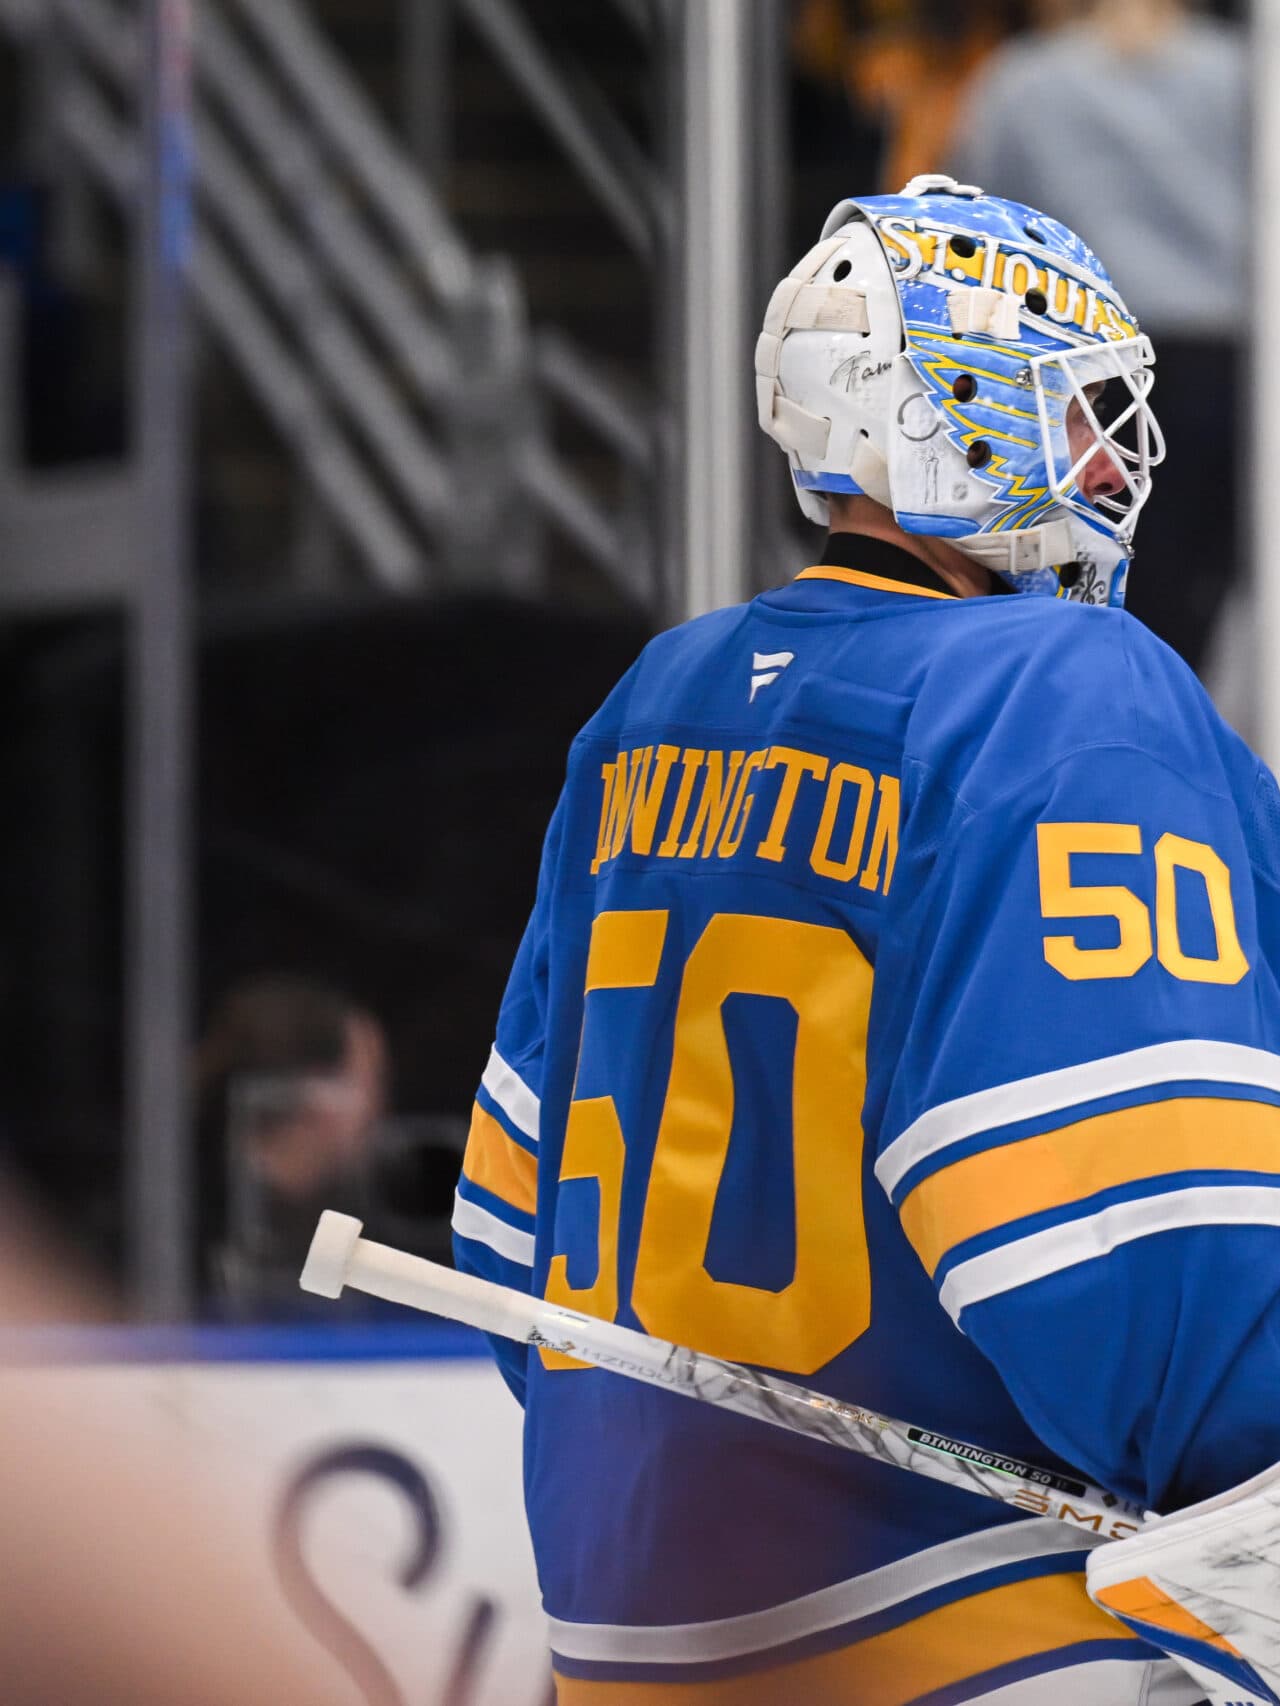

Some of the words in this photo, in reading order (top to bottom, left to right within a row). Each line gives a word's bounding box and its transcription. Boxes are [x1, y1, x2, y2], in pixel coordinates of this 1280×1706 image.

[1035, 821, 1250, 986] 50
[539, 908, 875, 1375] 50
[918, 1432, 1027, 1477] BINNINGTON
[1029, 1470, 1052, 1485] 50
